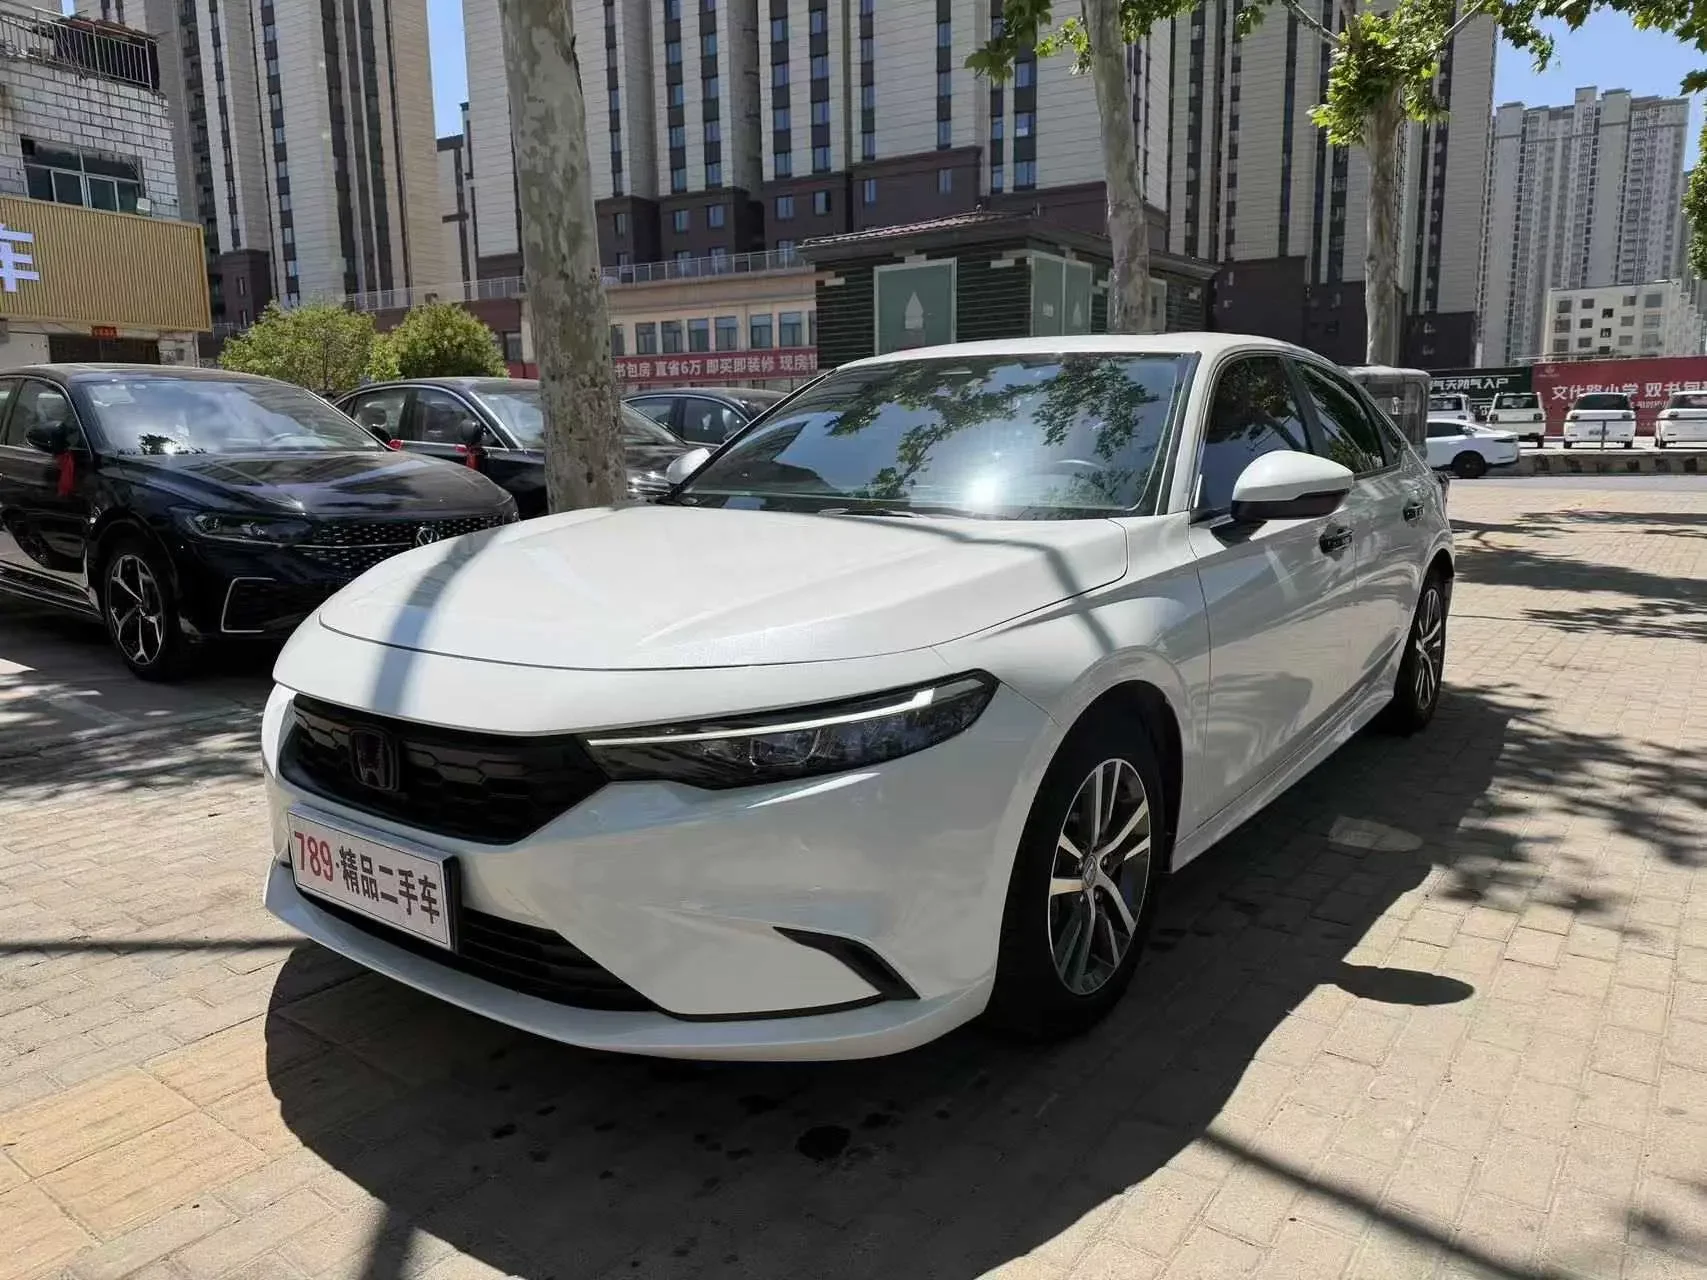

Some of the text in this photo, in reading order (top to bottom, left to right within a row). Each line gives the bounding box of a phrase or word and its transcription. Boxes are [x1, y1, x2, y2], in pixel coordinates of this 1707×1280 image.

[655, 360, 701, 378] 直省6万
[706, 356, 776, 375] 即买即装修
